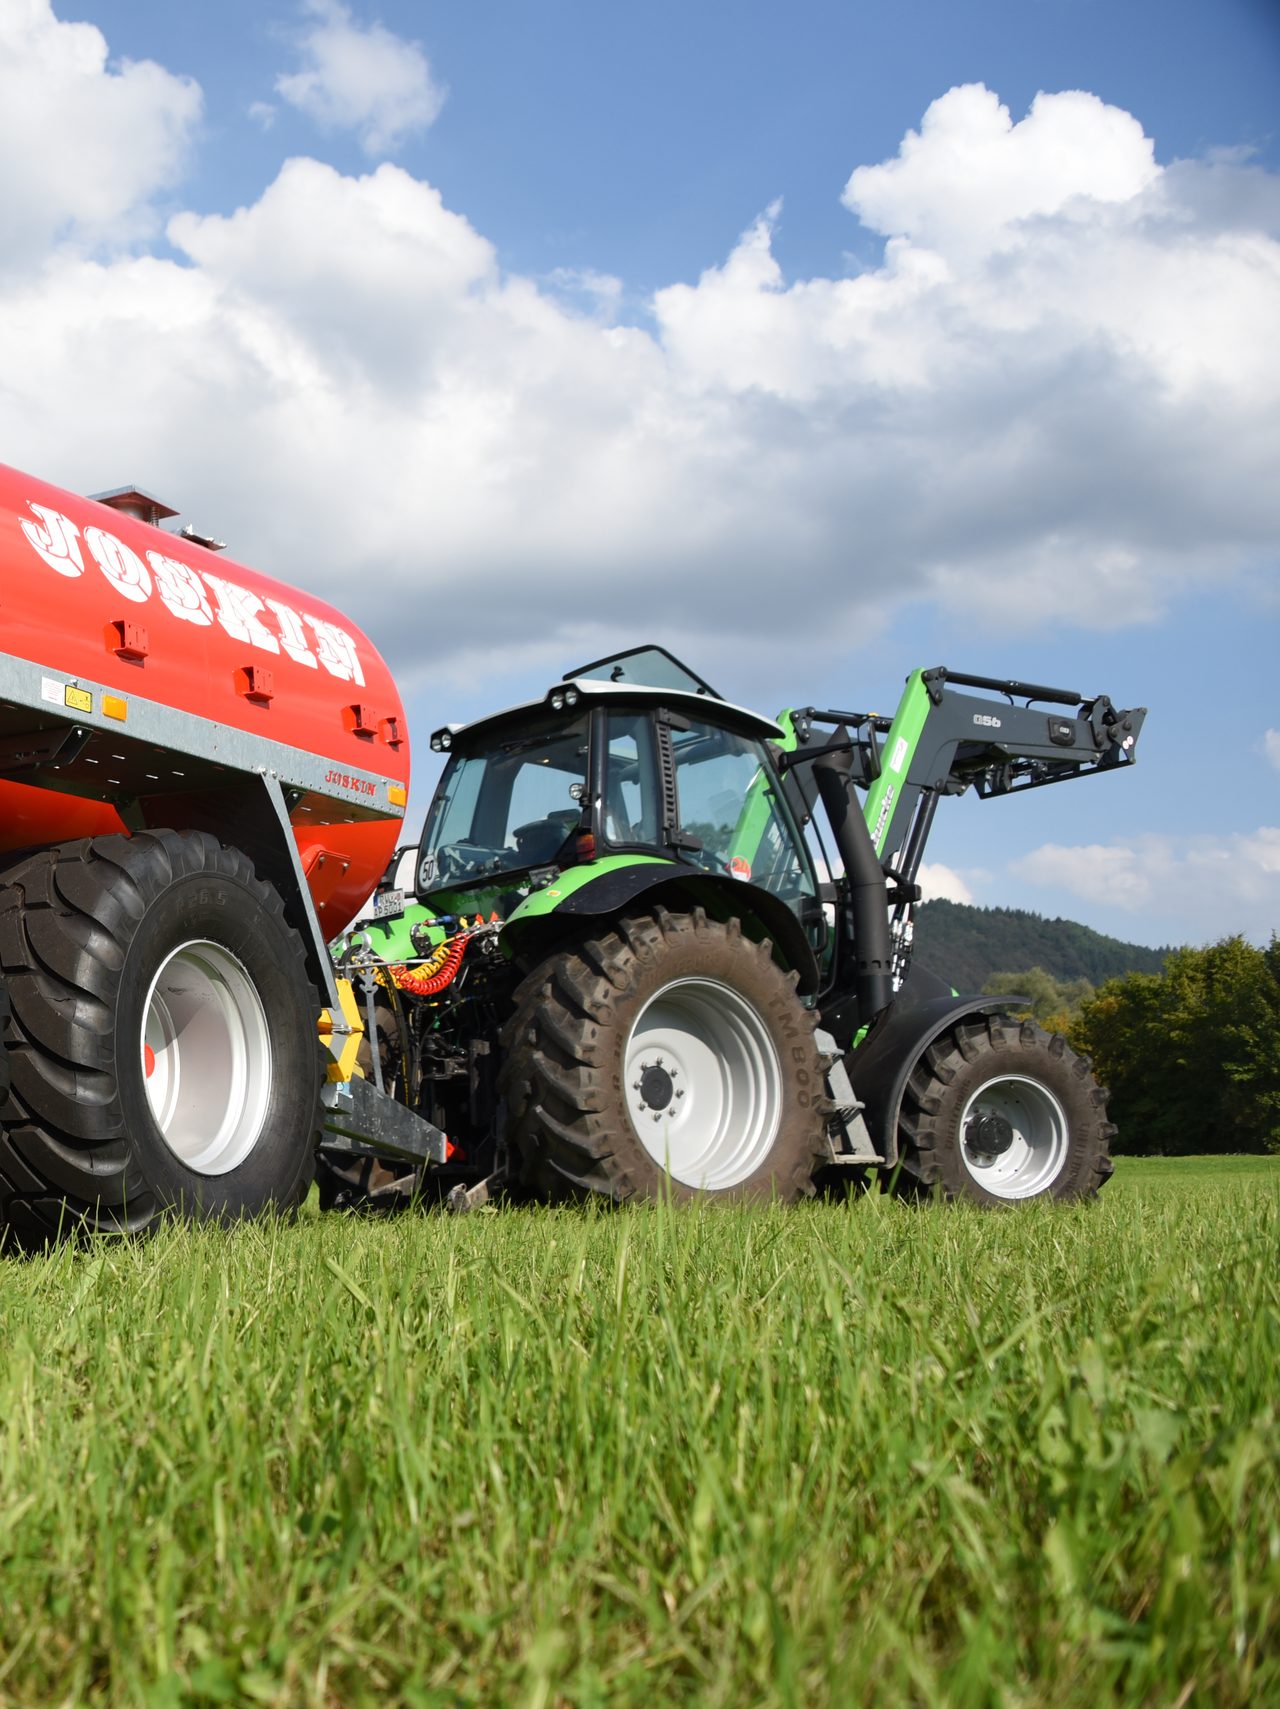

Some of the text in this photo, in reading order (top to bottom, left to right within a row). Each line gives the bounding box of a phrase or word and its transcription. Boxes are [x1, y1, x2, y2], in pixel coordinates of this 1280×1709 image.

[18, 500, 366, 687] JOSKIN
[324, 769, 377, 797] JOSKIN
[423, 859, 435, 882] 50
